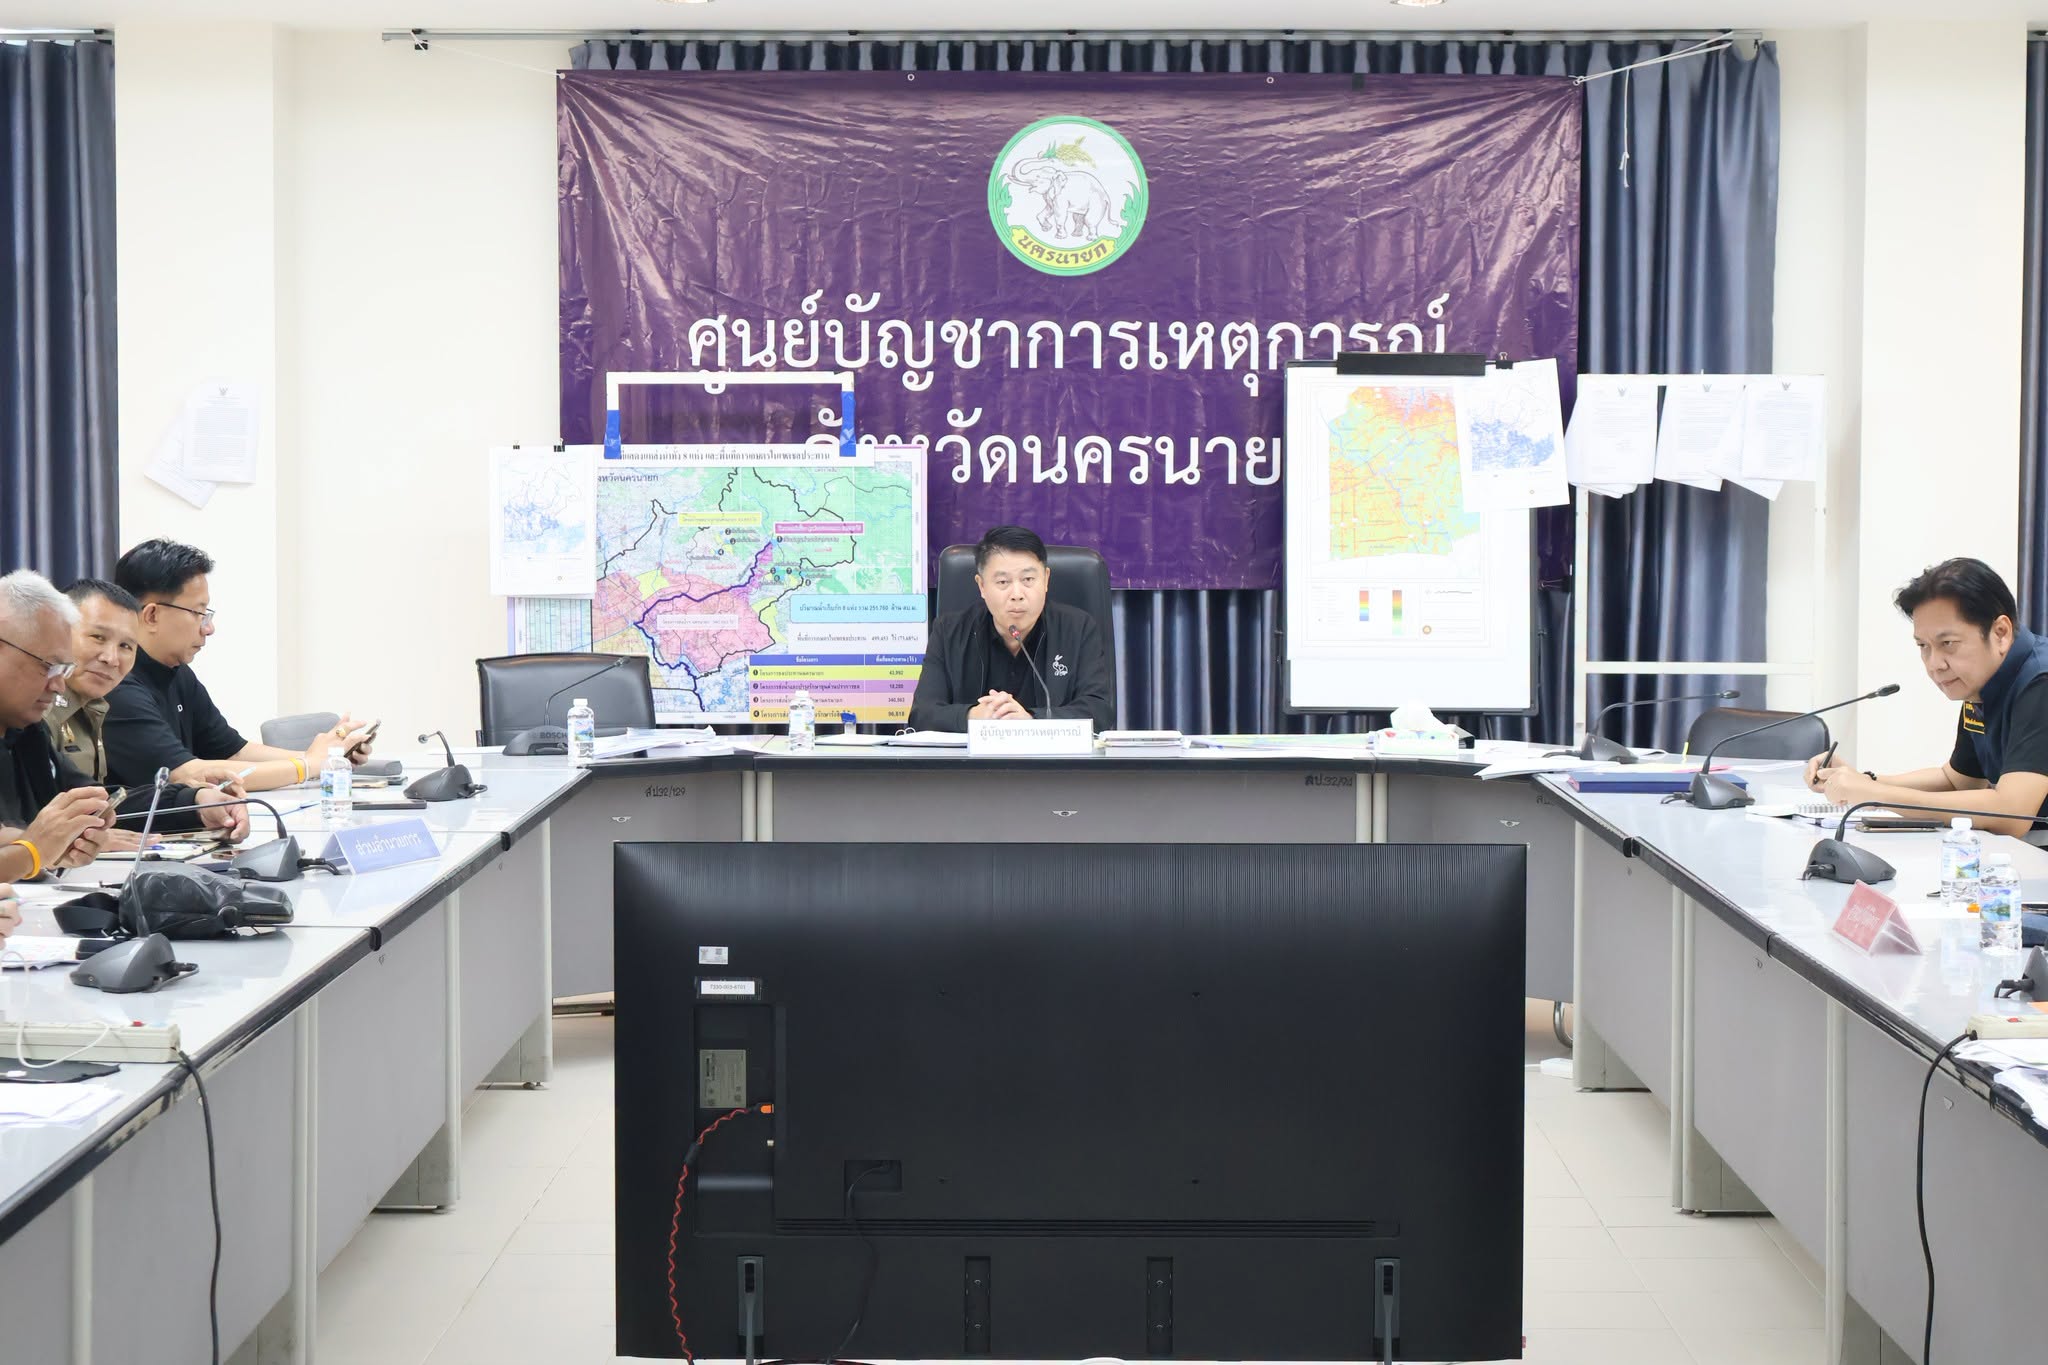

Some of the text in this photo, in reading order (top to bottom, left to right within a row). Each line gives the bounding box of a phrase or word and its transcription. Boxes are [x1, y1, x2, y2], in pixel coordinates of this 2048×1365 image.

[1017, 235, 1107, 264] นครนายก
[688, 289, 1450, 396] ศูนย์บัญชาการเหตุการณ์
[805, 407, 1281, 486] ัวัดนครนาย
[597, 472, 659, 482] งหวัดนครนายก
[540, 731, 568, 739] BOSCH
[979, 724, 1082, 741] ผู้บัญชาการเหตุการณ์
